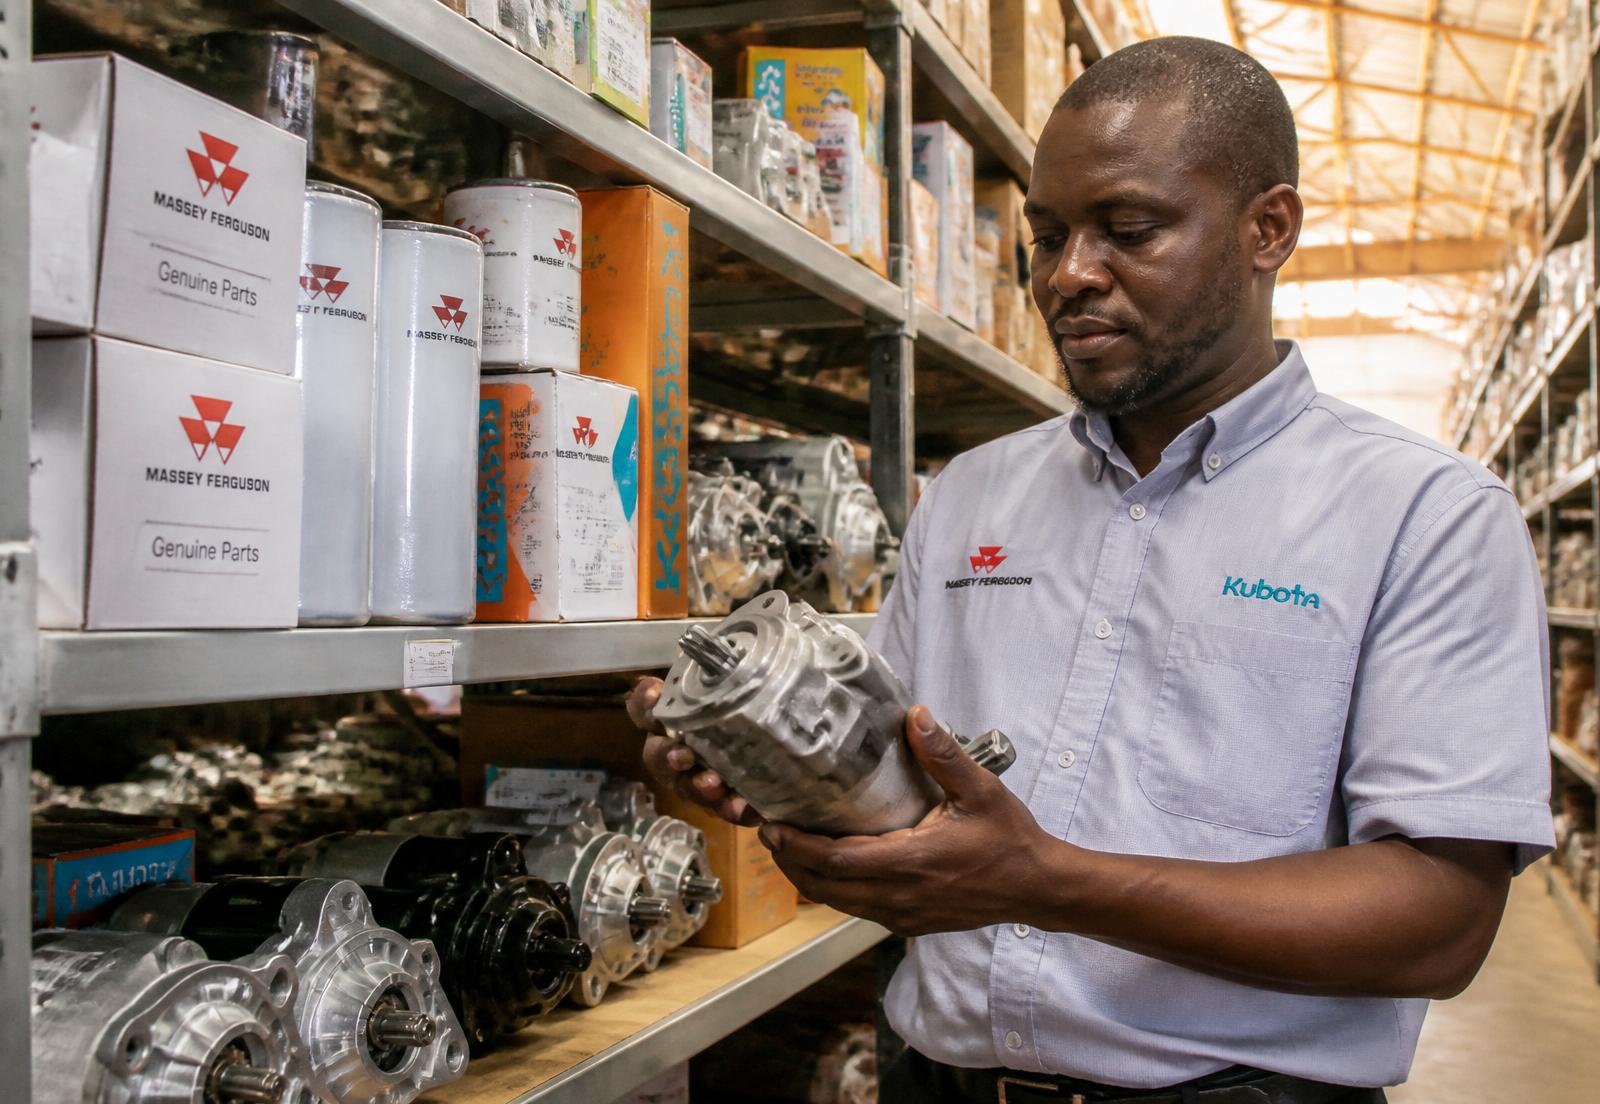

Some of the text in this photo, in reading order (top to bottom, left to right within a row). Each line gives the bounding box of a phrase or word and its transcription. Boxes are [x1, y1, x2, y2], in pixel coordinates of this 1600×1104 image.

[153, 190, 270, 242] MASSEY FERGUSON
[158, 260, 257, 306] Genuine Parts
[146, 467, 270, 492] MASSEY FERGUSON
[152, 536, 259, 562] Genuine Parts
